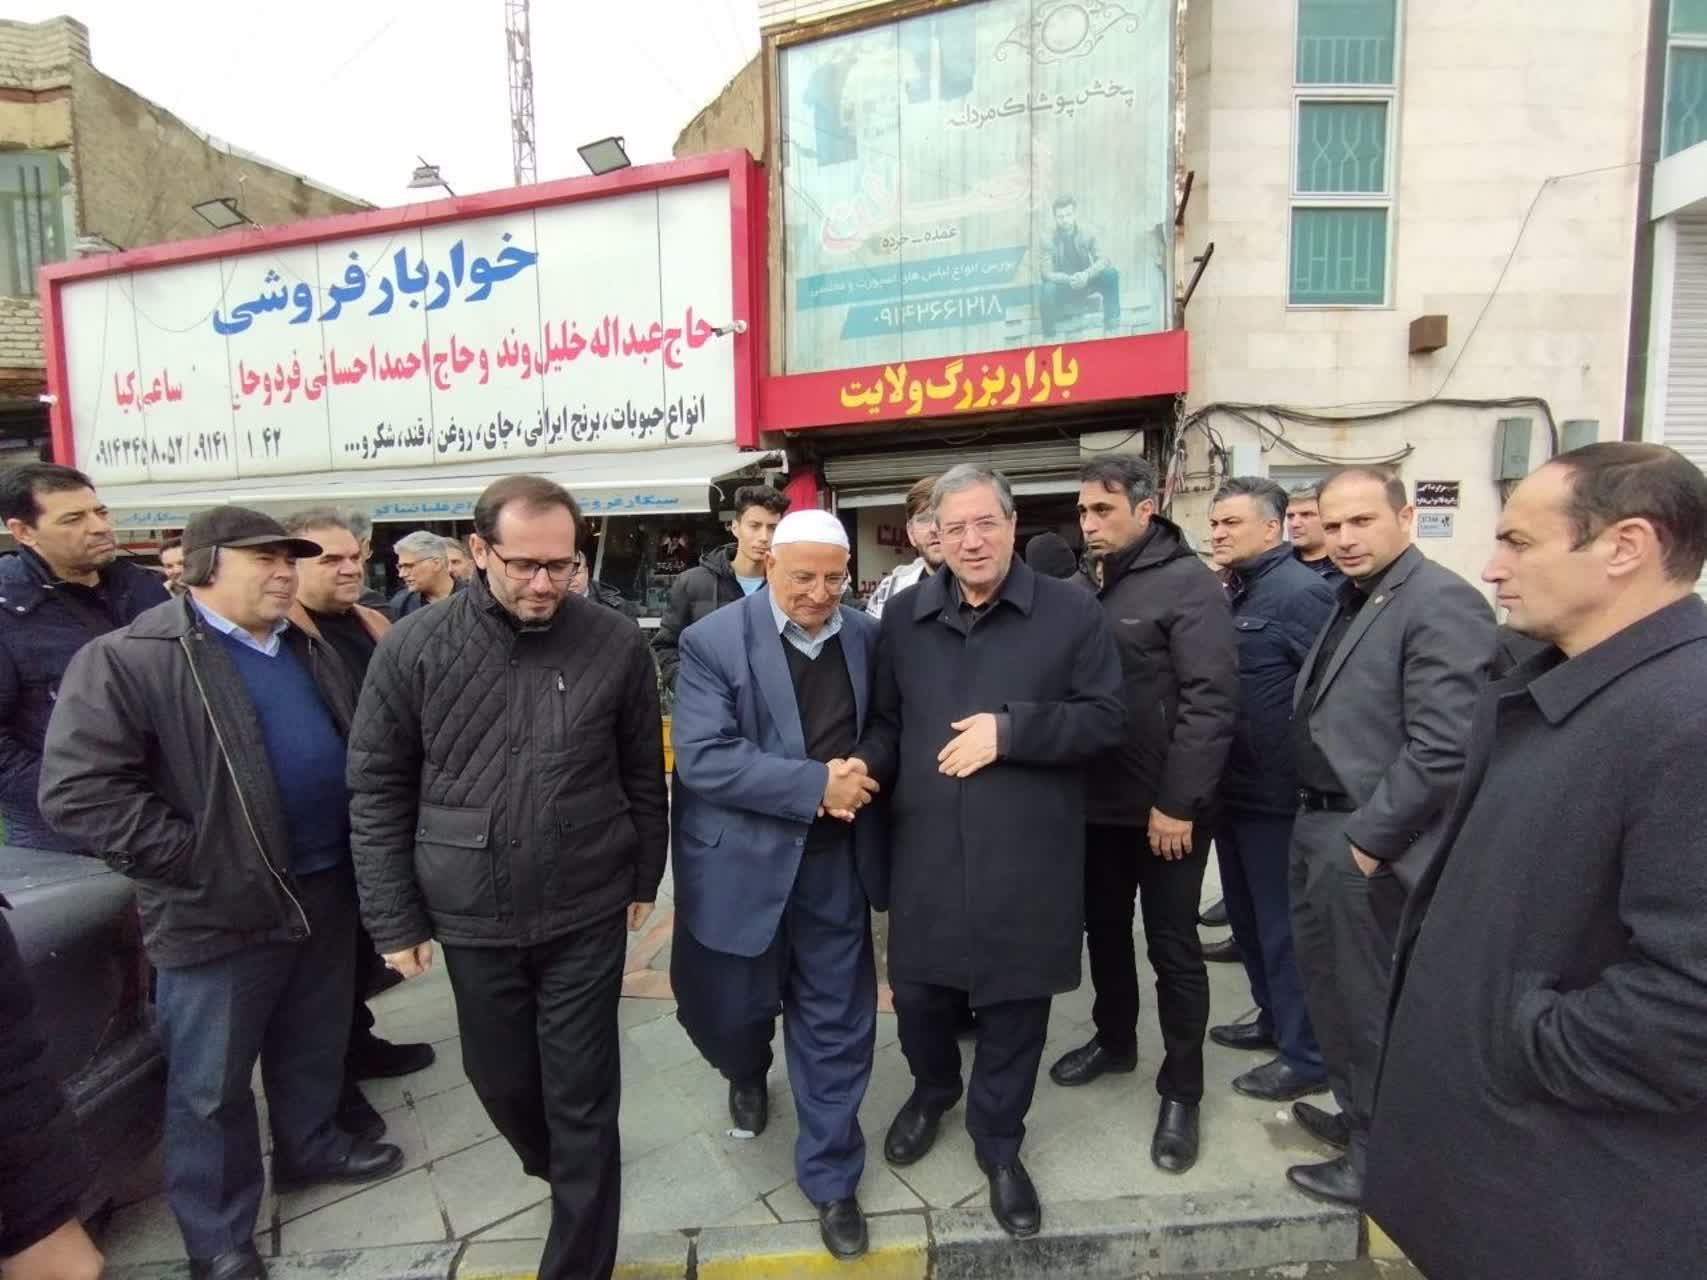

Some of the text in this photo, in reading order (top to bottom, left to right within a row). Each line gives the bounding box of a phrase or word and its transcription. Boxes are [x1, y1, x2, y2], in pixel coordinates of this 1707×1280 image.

[998, 92, 1075, 117] پوشاک
[1076, 80, 1134, 107] پخش
[924, 227, 959, 242] عمده
[663, 306, 713, 369] حاج
[304, 344, 377, 401] احسانی
[379, 340, 431, 381] احمد
[432, 334, 475, 390] حاج
[840, 346, 1079, 415] بازار بزرگ ولایت
[571, 404, 600, 442] برنج
[667, 394, 705, 439] انواع
[371, 421, 395, 459] شکر
